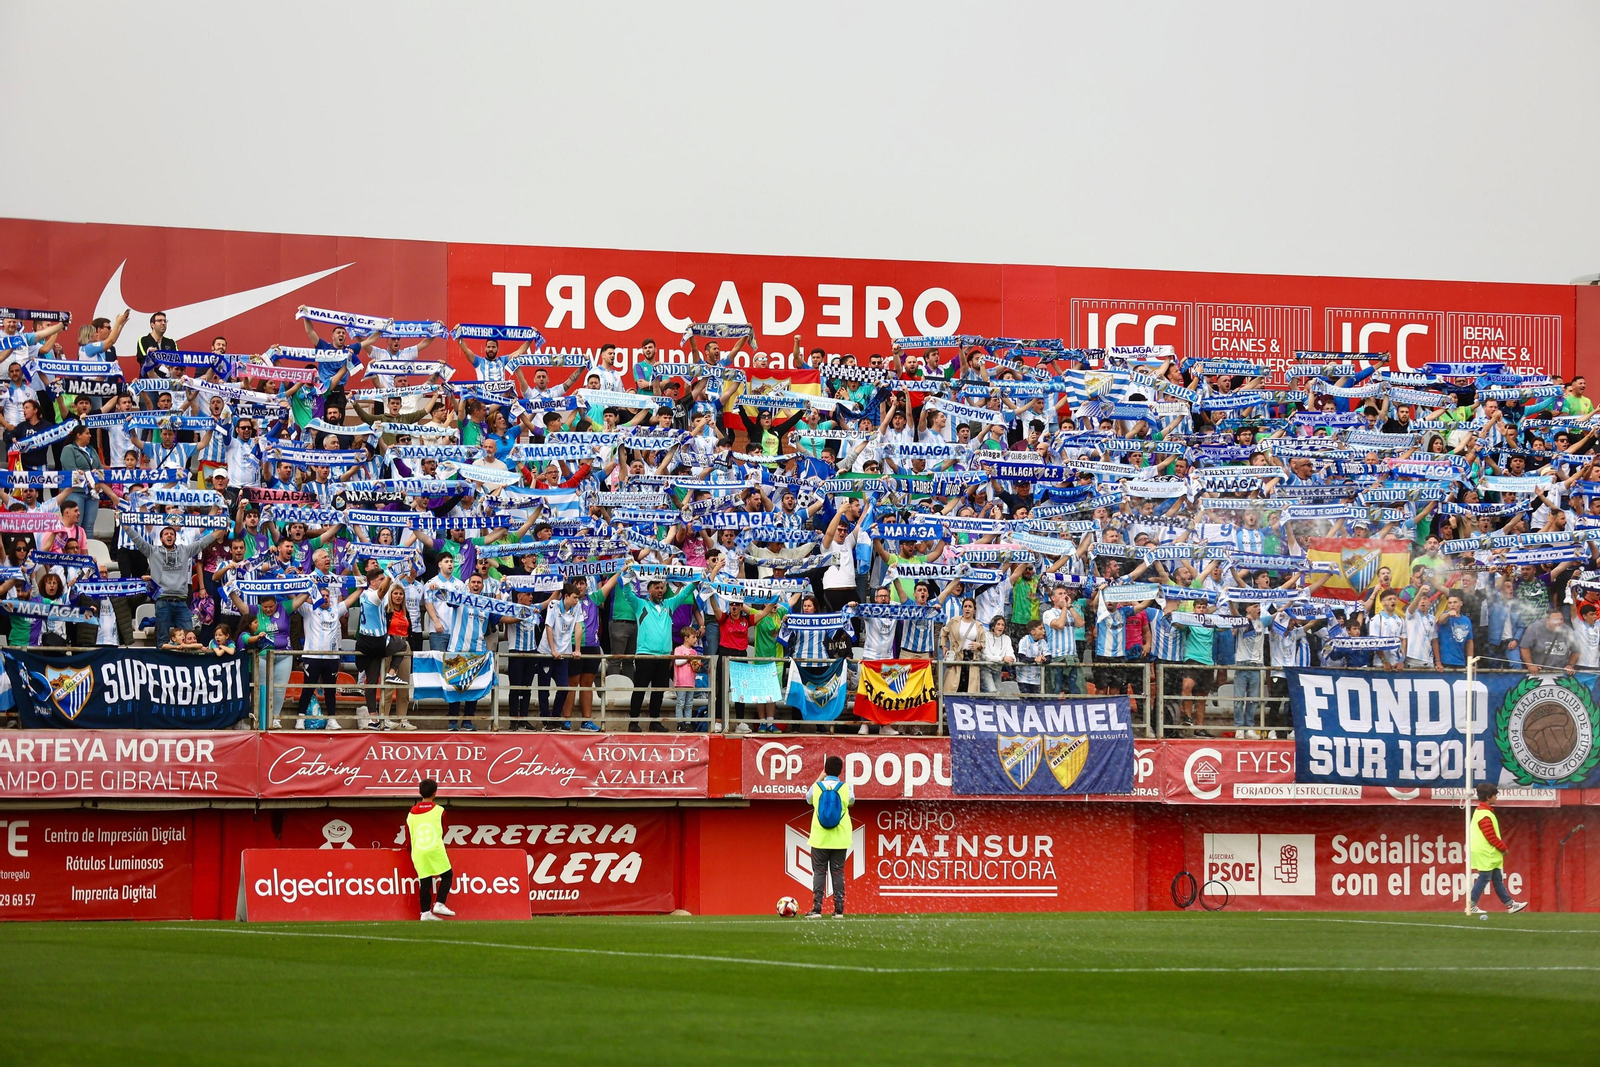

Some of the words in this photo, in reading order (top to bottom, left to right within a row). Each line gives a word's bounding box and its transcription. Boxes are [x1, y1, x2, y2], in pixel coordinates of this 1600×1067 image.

[30, 312, 58, 320] SUPERBASTI
[310, 310, 355, 323] MALAGA
[357, 318, 376, 326] C.F.
[462, 326, 493, 337] CONTIGO
[506, 329, 536, 338] MALAGA
[1212, 317, 1254, 333] IBERIA
[1088, 313, 1177, 367] ICC
[1463, 326, 1505, 341] IBERIA
[285, 348, 344, 358] MALAGA
[1212, 338, 1266, 356] CRANES
[1270, 343, 1281, 357] &
[1342, 323, 1429, 375] ICC
[1463, 345, 1517, 362] CRANES
[1520, 348, 1531, 362] &
[41, 362, 71, 371] PORQUE
[81, 364, 107, 372] QUIERO
[370, 362, 414, 372] MALAGA
[250, 368, 313, 381] MALAGUISTA
[1390, 372, 1427, 381] MALAGA
[68, 381, 117, 395] MALAGA
[889, 380, 937, 389] MALAGA
[1483, 390, 1520, 400] FONDO
[1534, 386, 1558, 396] SUR
[1208, 395, 1257, 408] MALAGA
[557, 433, 618, 447] MALAGA
[403, 448, 463, 457] MALAGA
[525, 446, 567, 456] MALAGA
[570, 445, 588, 455] C.F.
[899, 445, 950, 455] MALAGA
[1157, 443, 1183, 453] SUR
[292, 453, 343, 462] MALAGA
[111, 470, 168, 481] MALAGA
[1000, 466, 1033, 477] MALAGA
[1044, 467, 1060, 478] C.F.
[1242, 467, 1273, 475] COMEPIPAS
[1398, 464, 1453, 478] MALAGA
[393, 480, 448, 494] MALAGA
[912, 480, 934, 494] PADRES
[1206, 479, 1257, 489] MALAGA
[156, 491, 201, 503] MALAGA
[250, 490, 310, 501] MALAGA
[1288, 488, 1326, 496] MALAGA
[1367, 490, 1406, 500] FONDO
[1037, 505, 1077, 518] FONDO
[1091, 495, 1116, 507] SUR
[1290, 508, 1316, 516] PORQUE
[1326, 506, 1349, 514] QUIERO
[275, 510, 339, 522] MALAGA
[352, 513, 380, 522] PORQUE
[418, 516, 502, 529] SUPERBASTI
[1, 520, 62, 530] MALAGUISTA
[883, 526, 935, 538] MALAGA
[1070, 521, 1094, 531] SUR
[628, 530, 672, 551] MALAGA
[1444, 538, 1479, 550] FONDO
[1493, 536, 1517, 549] SUR
[1527, 532, 1570, 545] FONDO
[1243, 556, 1292, 565] MALAGA
[1517, 550, 1563, 560] MALAGA
[557, 564, 603, 577] MALAGA
[605, 562, 617, 573] CF
[639, 566, 693, 578] ALAMEDA
[897, 565, 939, 576] MALAGA
[940, 565, 956, 575] C.F.
[240, 583, 271, 591] PORQUE
[284, 581, 310, 590] QUIERO
[744, 579, 798, 589] MALAGA
[716, 584, 772, 600] ALAMEDA
[17, 602, 80, 618] MALAGA
[450, 592, 515, 615] MALAGA
[101, 658, 244, 706] SUPERBASTI
[1298, 673, 1489, 736] FONDO
[1556, 688, 1581, 711] CLUB
[1576, 711, 1589, 729] DE
[952, 702, 1128, 734] BENAMIEL
[957, 733, 976, 741] PEÑA
[1090, 733, 1129, 741] MALAGUISTA
[1510, 729, 1524, 753] 1904
[116, 738, 215, 763] MOTOR
[364, 746, 449, 762] AROMA
[455, 746, 487, 762] DE
[581, 747, 663, 762] AROMA
[669, 747, 701, 763] DE
[1053, 738, 1083, 767] BENAMIEL
[1308, 735, 1388, 779] SUR
[1398, 739, 1487, 780] 1904
[268, 746, 373, 786] Catering
[487, 746, 588, 787] Catering
[1236, 751, 1295, 774] FYES
[1521, 755, 1556, 777] DESDE
[65, 771, 94, 791] DE
[101, 771, 218, 792] GIBRALTAR
[377, 768, 473, 785] AZAHAR
[595, 769, 687, 785] AZAHAR
[751, 785, 808, 795] ALGECIRAS
[1236, 786, 1285, 797] FORJADOS
[1286, 786, 1293, 796] Y
[1295, 785, 1359, 796] ESTRUCTURAS
[1497, 787, 1554, 797] STRUCTURAS
[876, 810, 956, 832] GRUPO
[44, 828, 79, 843] Centro
[82, 827, 94, 843] de
[98, 827, 149, 846] Impresión
[152, 826, 187, 845] Digital
[878, 834, 1055, 858] MAINSUR
[66, 855, 106, 871] Rótulos
[109, 855, 164, 870] Luminosos
[1208, 853, 1235, 861] ALGECIRAS
[877, 860, 1058, 881] CONSTRUCTORA
[1208, 862, 1256, 882] PSOE
[1331, 872, 1379, 897] con
[1387, 865, 1411, 897] el
[1420, 865, 1523, 903] depe
[12, 894, 24, 906] 69
[25, 893, 37, 906] 57
[72, 885, 119, 904] Imprenta
[122, 884, 157, 903] Digital
